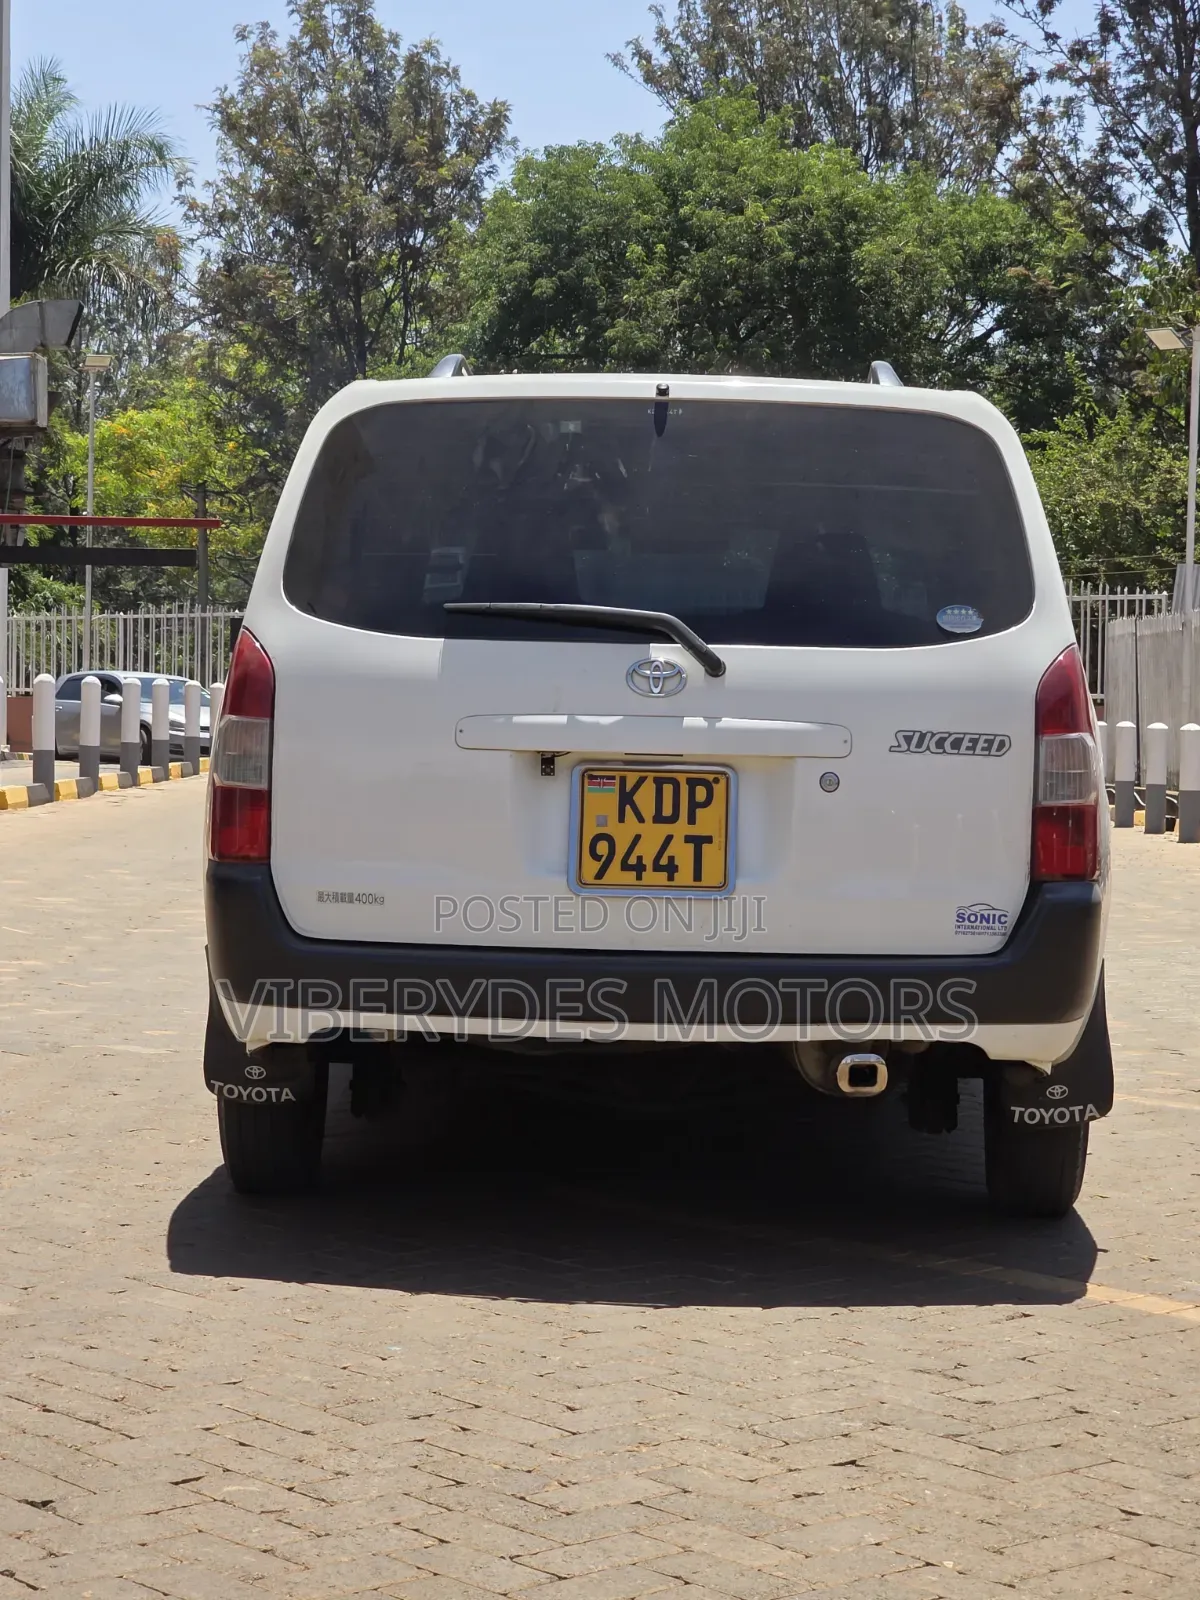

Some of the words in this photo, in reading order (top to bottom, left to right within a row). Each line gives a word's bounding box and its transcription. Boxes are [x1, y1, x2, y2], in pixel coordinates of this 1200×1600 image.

[888, 730, 1012, 757] SUCCEED
[618, 775, 715, 825] KDP
[588, 832, 714, 882] 944T
[955, 912, 1008, 925] SONIC
[210, 1079, 297, 1103] TOYOTA
[1010, 1103, 1101, 1125] TOYOTA
